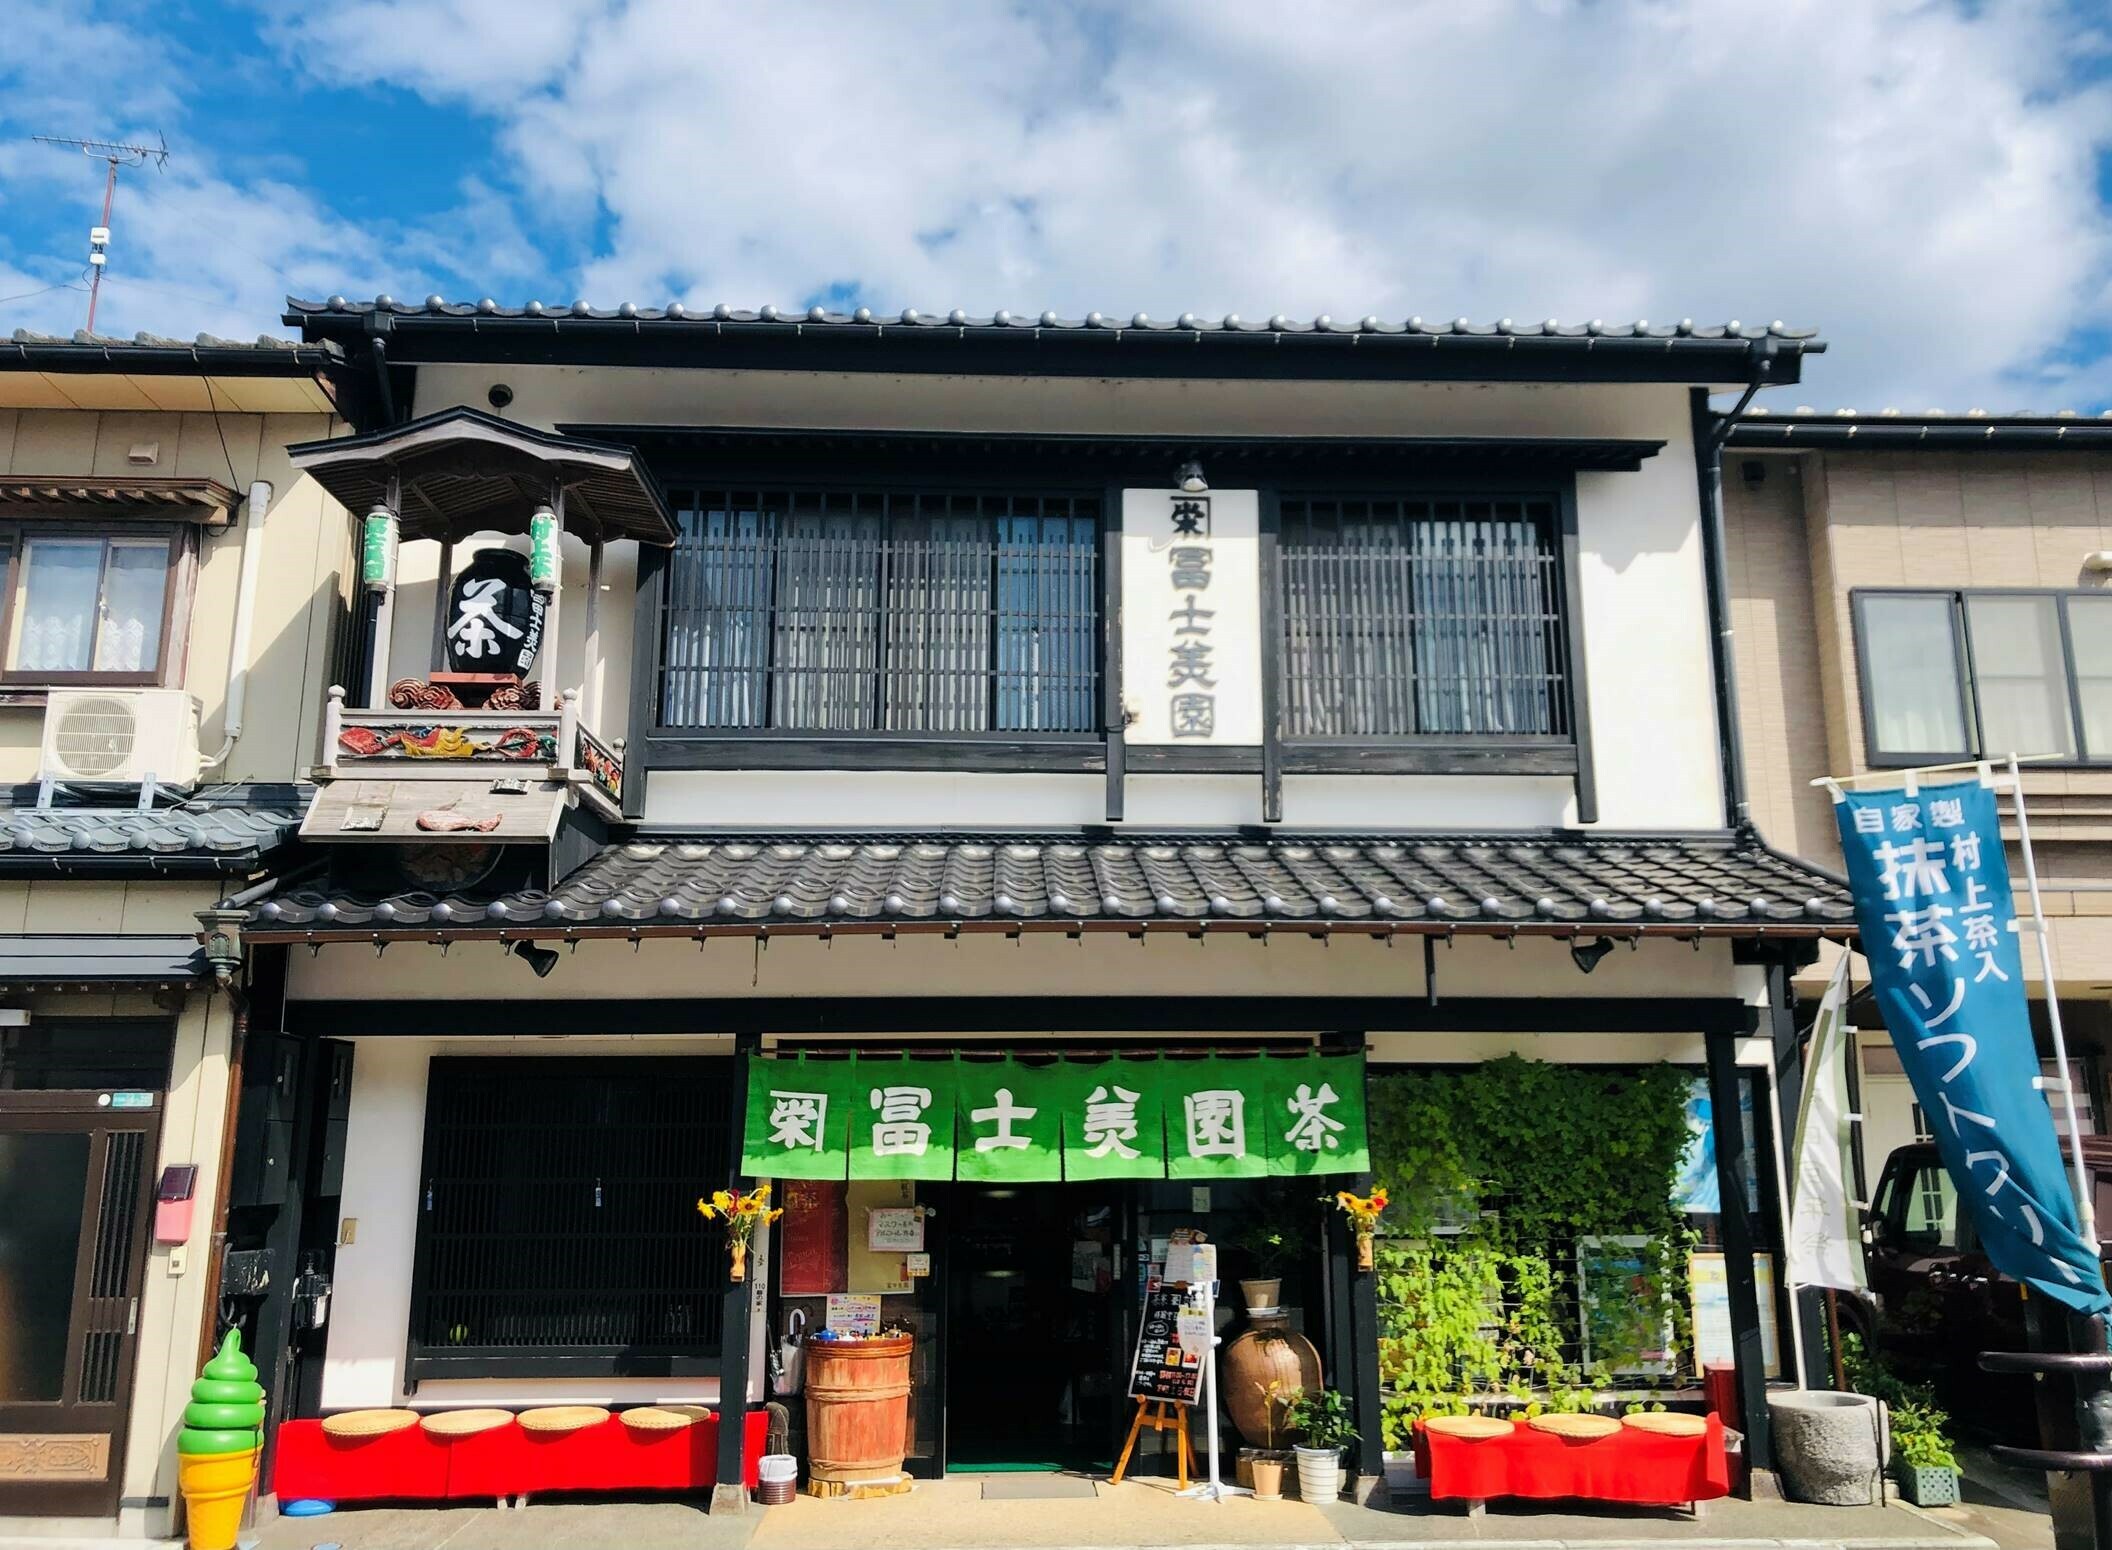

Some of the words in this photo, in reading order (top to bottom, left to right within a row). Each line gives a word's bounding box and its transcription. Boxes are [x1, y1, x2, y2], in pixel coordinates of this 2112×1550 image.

[447, 578, 525, 660] 茶
[1854, 797, 1966, 834] 自家製
[1949, 831, 2009, 984] 村上茶入
